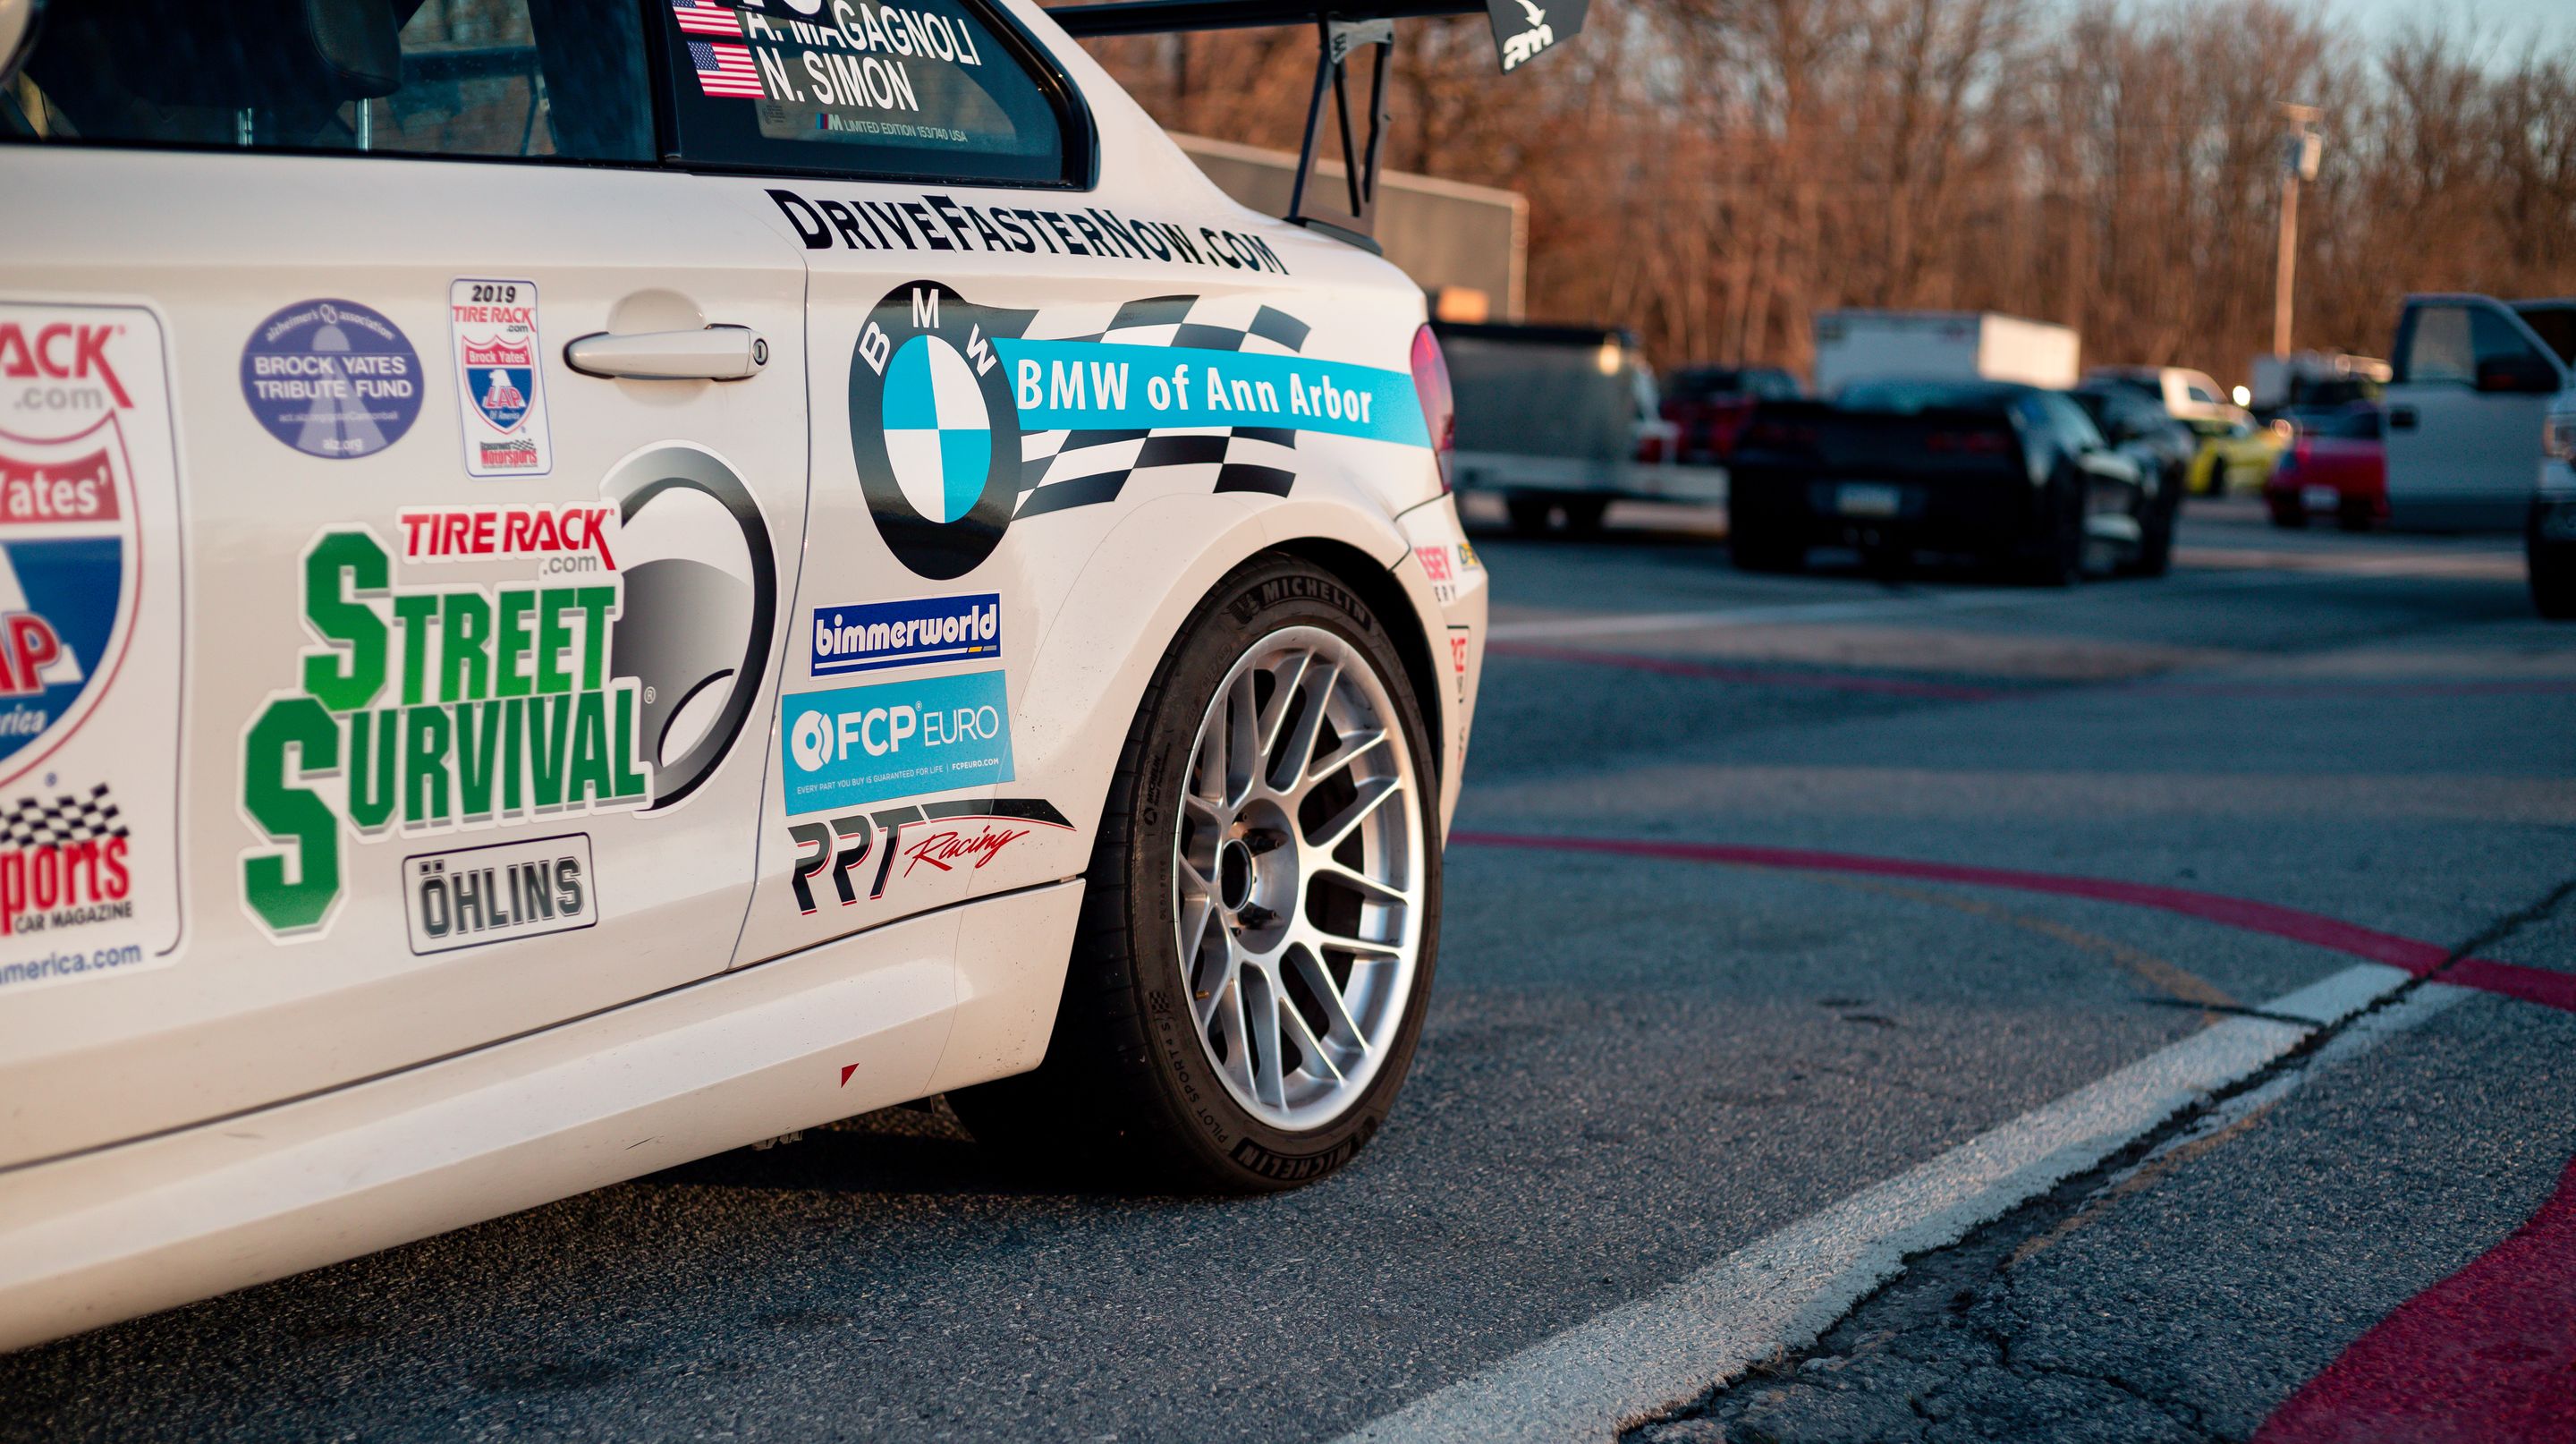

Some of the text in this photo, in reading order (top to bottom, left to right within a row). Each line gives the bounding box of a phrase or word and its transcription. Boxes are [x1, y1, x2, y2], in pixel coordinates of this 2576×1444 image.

[757, 46, 919, 112] N. SIMON
[844, 119, 880, 134] LIMITED
[881, 123, 917, 138] EDITION
[916, 125, 949, 141] 153/740
[950, 128, 969, 143] USA
[470, 285, 516, 303] 2019
[452, 305, 537, 333] TIRE RACK
[254, 356, 407, 377] BROCK YATES
[468, 350, 496, 363] Brock
[14, 386, 104, 411] .com
[253, 379, 413, 399] TRIBUTE FUND
[485, 386, 521, 408] LAP
[1017, 359, 1373, 424] BMW of Ann Arbor
[402, 509, 616, 571] TIRE RACK
[543, 556, 597, 575] .com
[1261, 576, 1368, 624] MICHELIN
[305, 532, 616, 714] STREET
[815, 603, 997, 657] bimmerworld
[923, 704, 1000, 748] EURO
[796, 758, 1000, 795] EVERY PART YOU BUY IS GUARANTEED FOR LIFE FCPEURO.COM
[244, 689, 648, 933] SURVIVAL
[903, 824, 1030, 879] Racing
[14, 901, 133, 934] CAR MAGAZINE
[418, 856, 584, 939] ÖHLINS
[1167, 1050, 1200, 1103] SPORT
[1196, 1108, 1229, 1144] PILOT
[1237, 1138, 1352, 1181] MICHELIN
